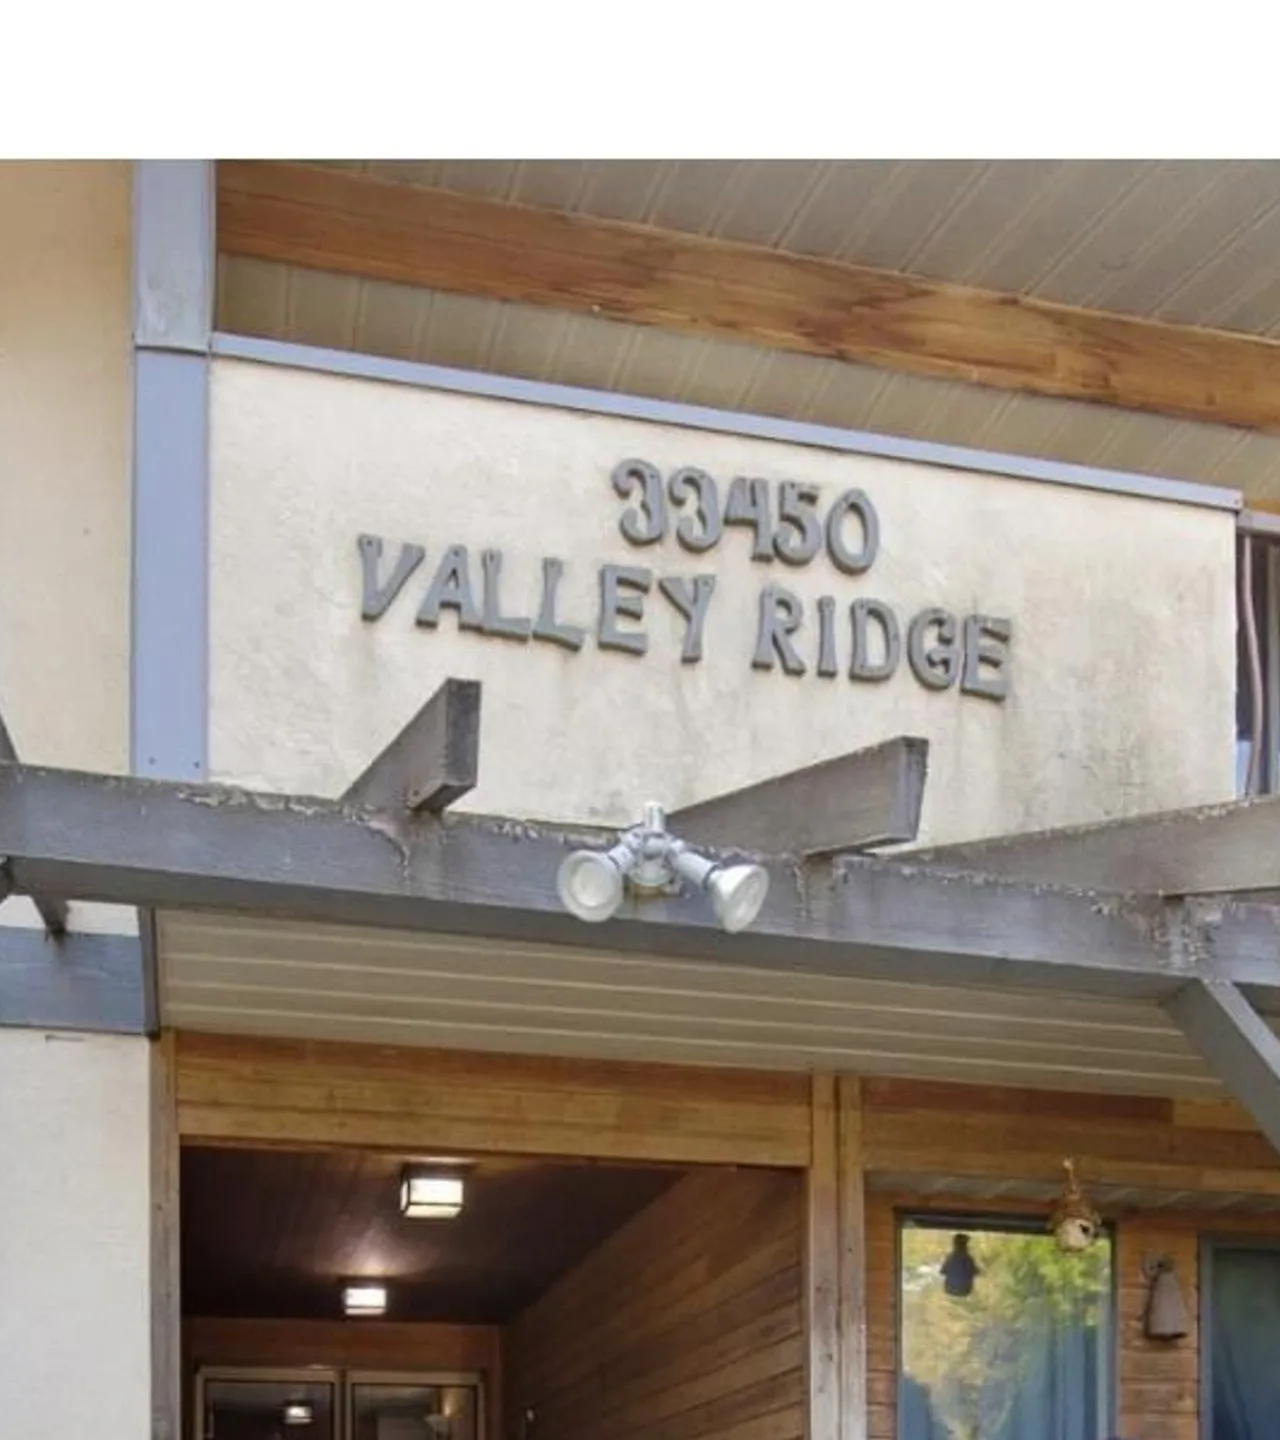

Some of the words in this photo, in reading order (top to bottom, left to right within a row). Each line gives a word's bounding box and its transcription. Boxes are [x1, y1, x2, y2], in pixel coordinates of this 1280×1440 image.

[611, 457, 881, 576] 33450
[357, 534, 717, 663] VALLEY
[751, 584, 1014, 702] RIDGE
